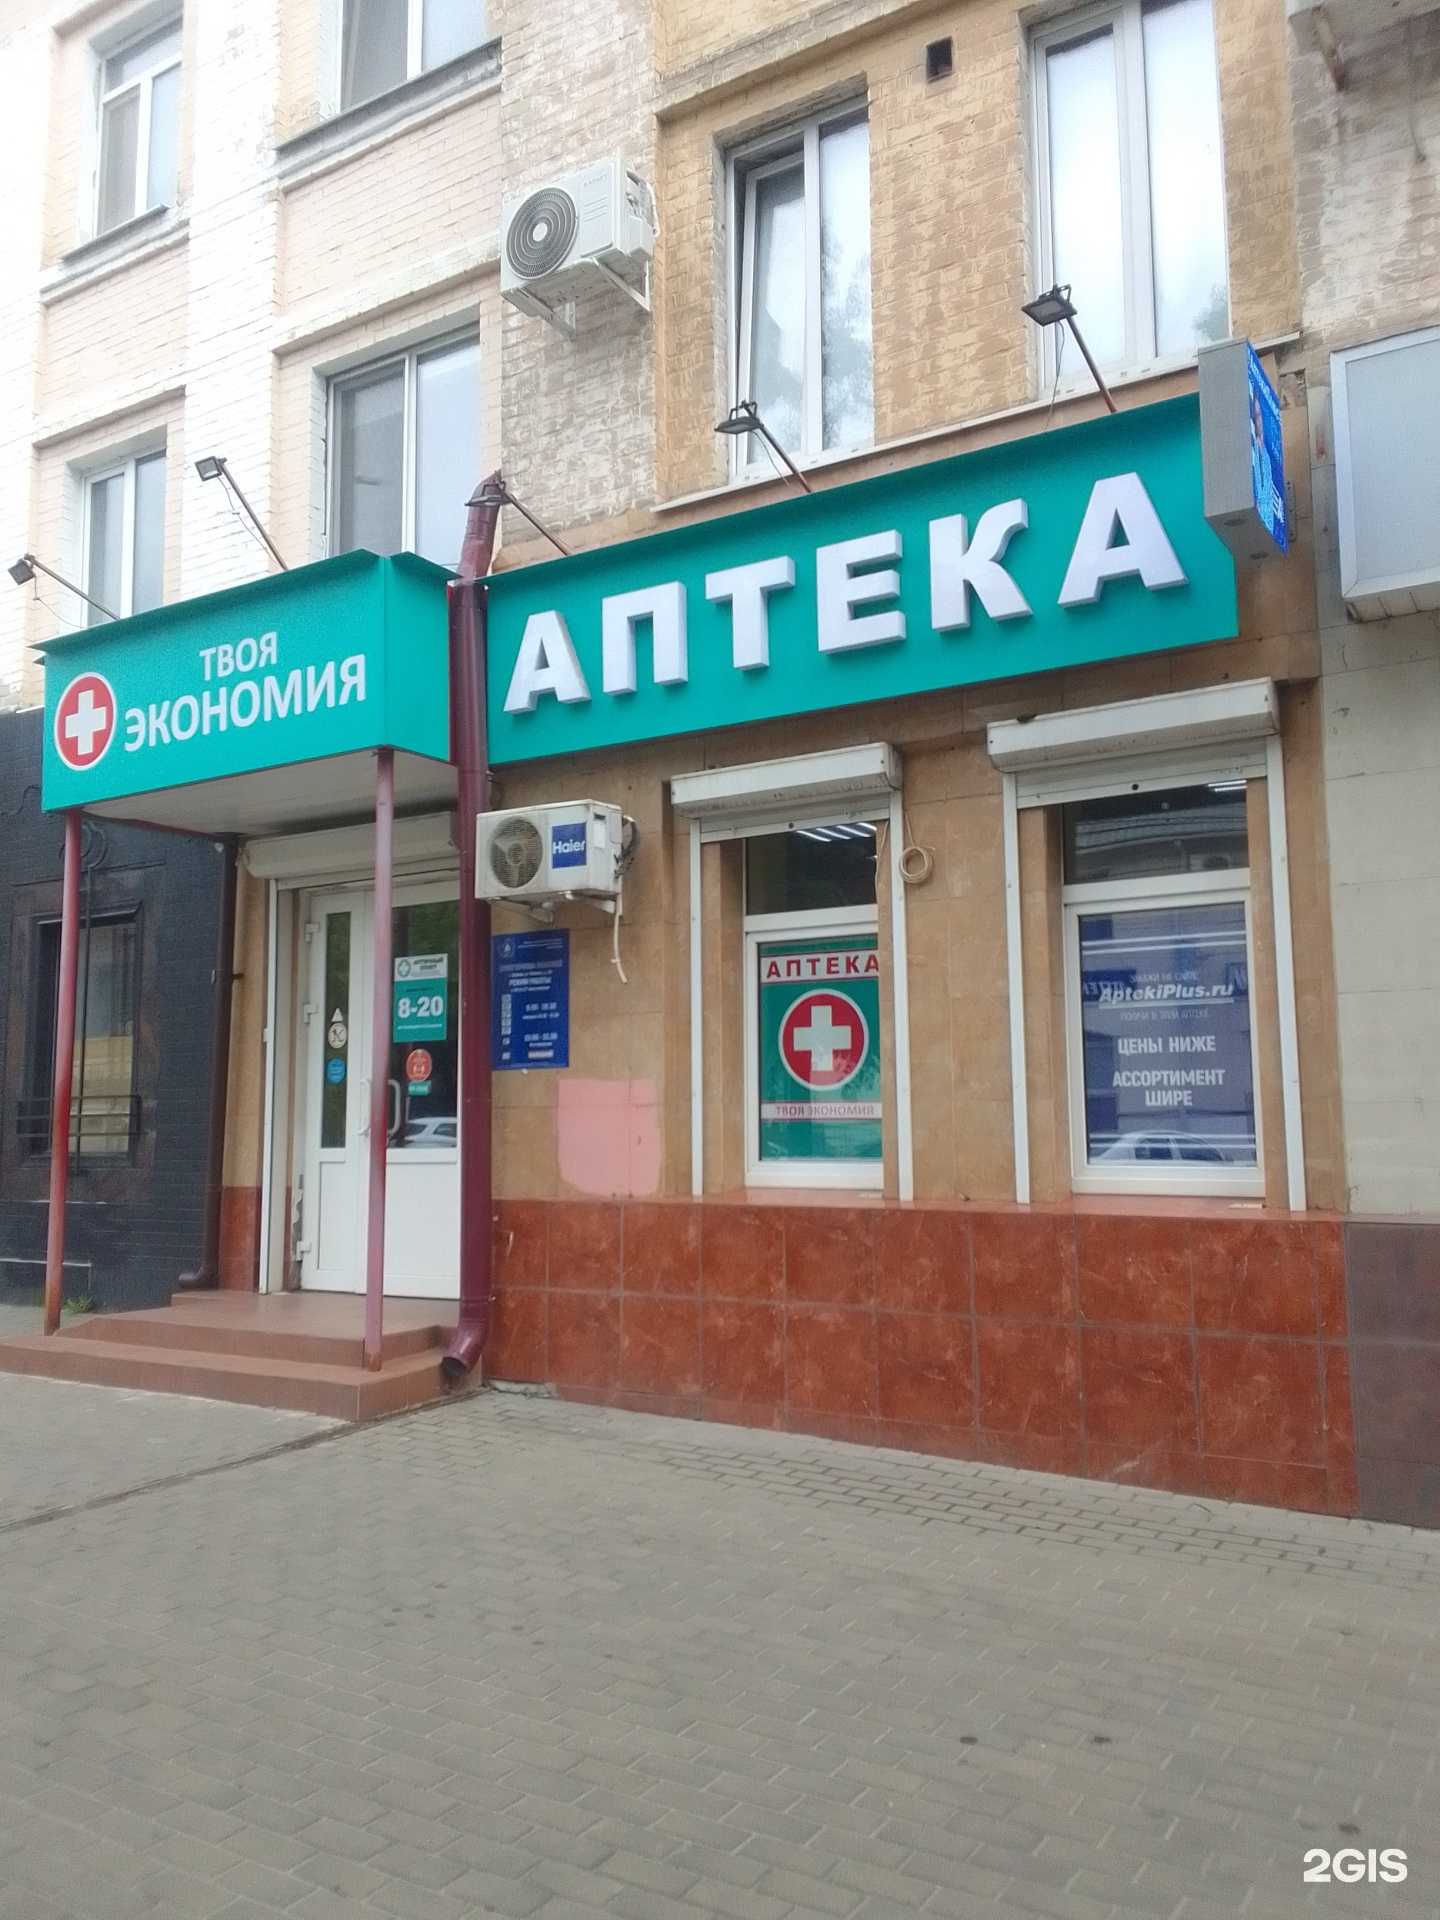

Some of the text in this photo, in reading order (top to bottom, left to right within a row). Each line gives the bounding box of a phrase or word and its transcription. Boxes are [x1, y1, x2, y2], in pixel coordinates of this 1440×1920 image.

[503, 471, 1190, 715] АПТЕКА
[199, 631, 278, 681] ТВОЯ
[123, 653, 367, 752] ЭКОНОМИЯ
[552, 839, 586, 854] Haier
[766, 953, 879, 979] АПТЕКА
[1100, 983, 1234, 1005] AptekiPlus.ru
[397, 995, 444, 1019] 8-20
[1117, 1035, 1216, 1056] ЦЕНЫ НИЖЕ
[1112, 1069, 1225, 1087] АССОРТИМЕНТ
[1144, 1089, 1193, 1107] ШИРЕ
